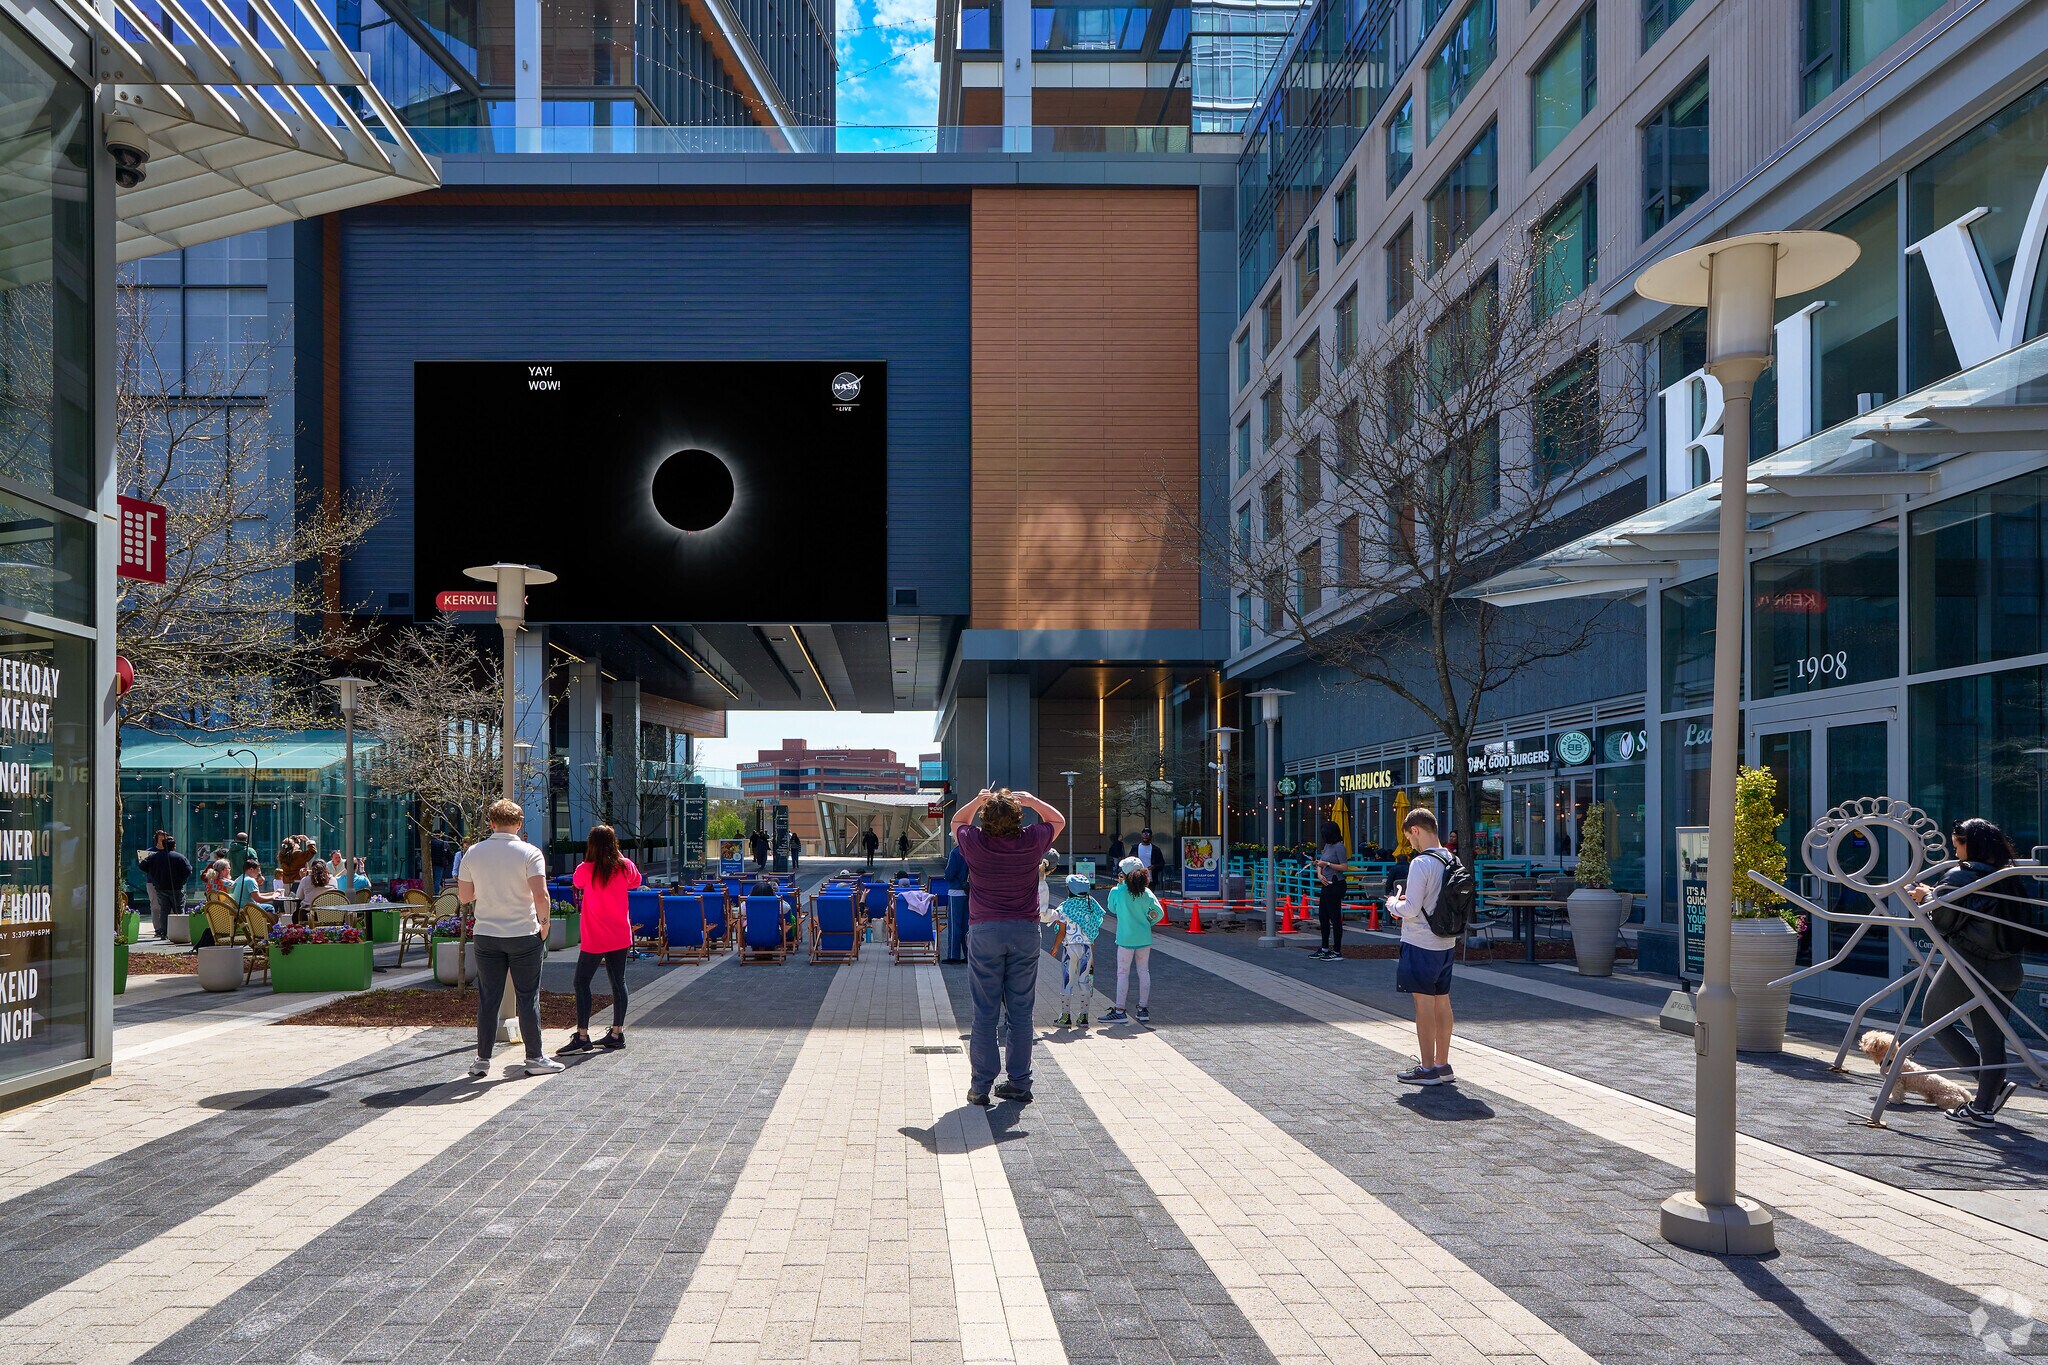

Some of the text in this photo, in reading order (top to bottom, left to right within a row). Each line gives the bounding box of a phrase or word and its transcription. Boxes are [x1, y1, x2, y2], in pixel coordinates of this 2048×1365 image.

[528, 366, 553, 376] YAY!
[528, 380, 561, 391] WOW!
[444, 595, 497, 605] KERRVILL
[1796, 650, 1847, 685] 1908
[0, 657, 60, 699] EEKDAY
[1418, 757, 1436, 777] BIG
[1489, 754, 1510, 769] GOOD
[1511, 749, 1550, 766] BURGERS
[1340, 769, 1391, 792] STARBUCKS
[1686, 886, 1706, 896] IT'S A
[11, 891, 51, 925] HOUR
[1687, 905, 1697, 914] TO
